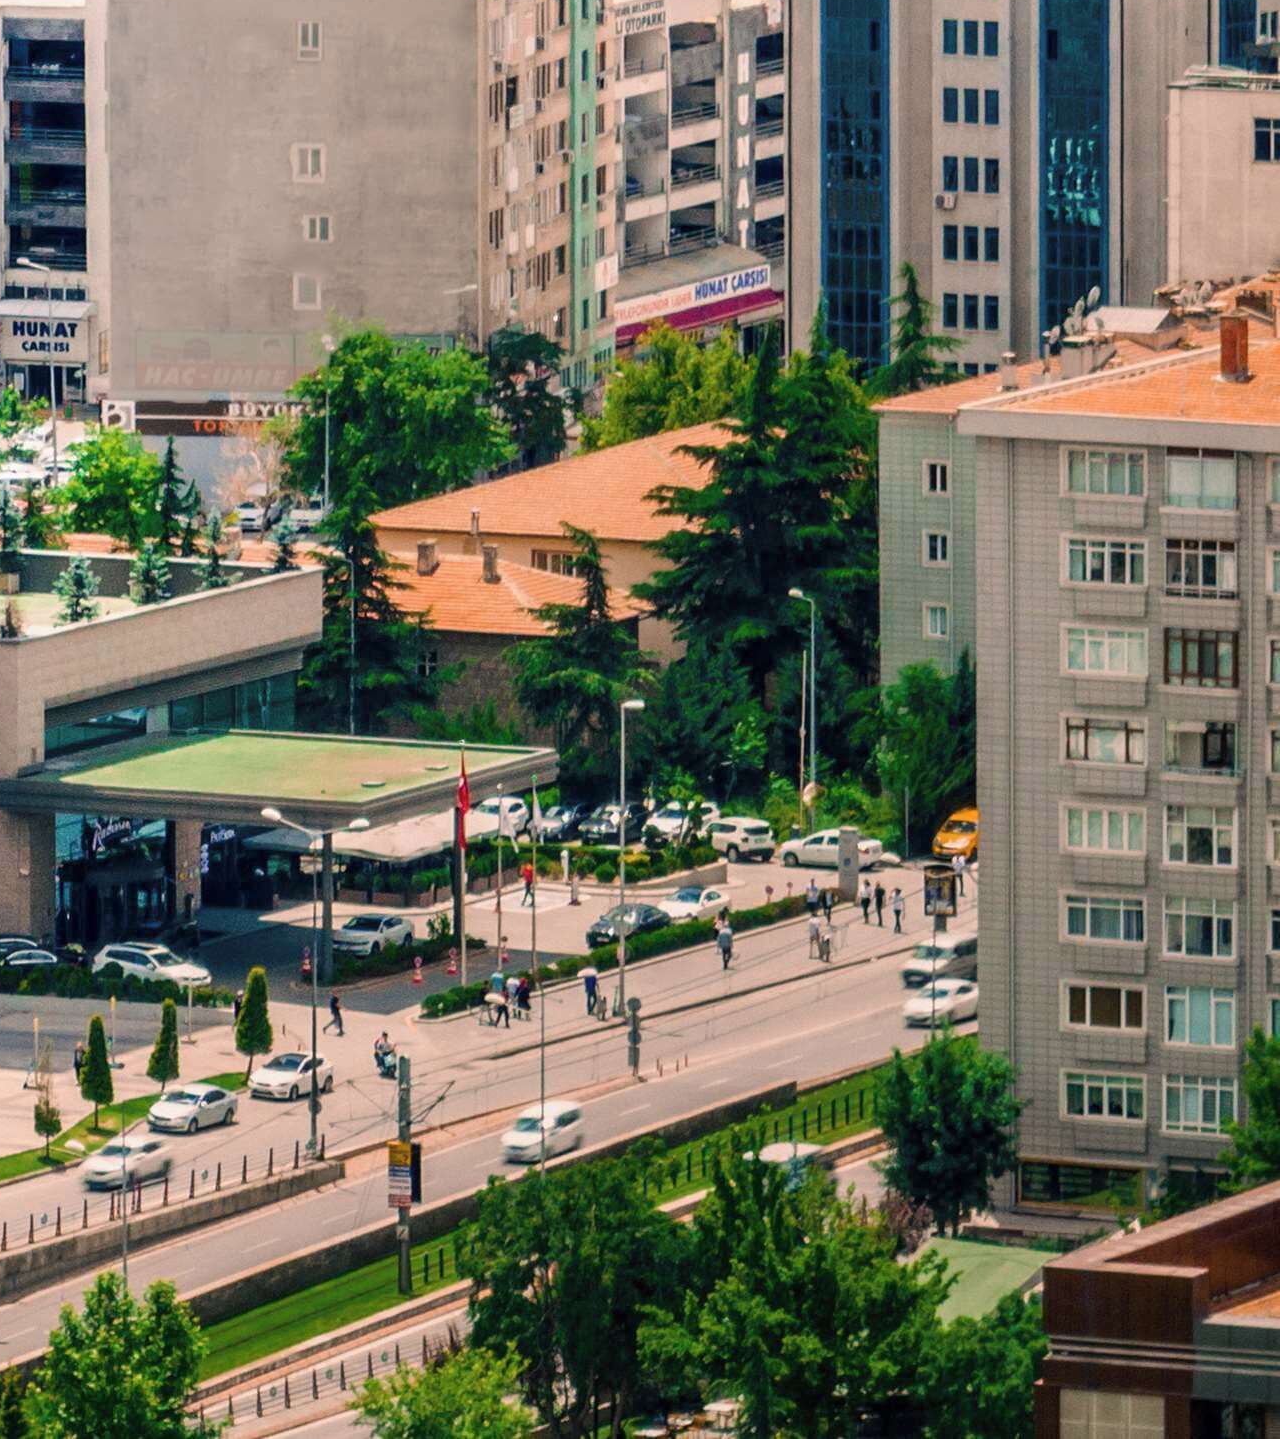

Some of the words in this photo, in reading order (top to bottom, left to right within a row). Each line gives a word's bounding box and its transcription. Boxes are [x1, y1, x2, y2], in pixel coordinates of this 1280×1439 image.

[737, 52, 750, 249] HUNAT
[694, 277, 728, 300] HUNAT
[731, 267, 768, 293] ÇARŞISI
[12, 321, 78, 338] HUNAT
